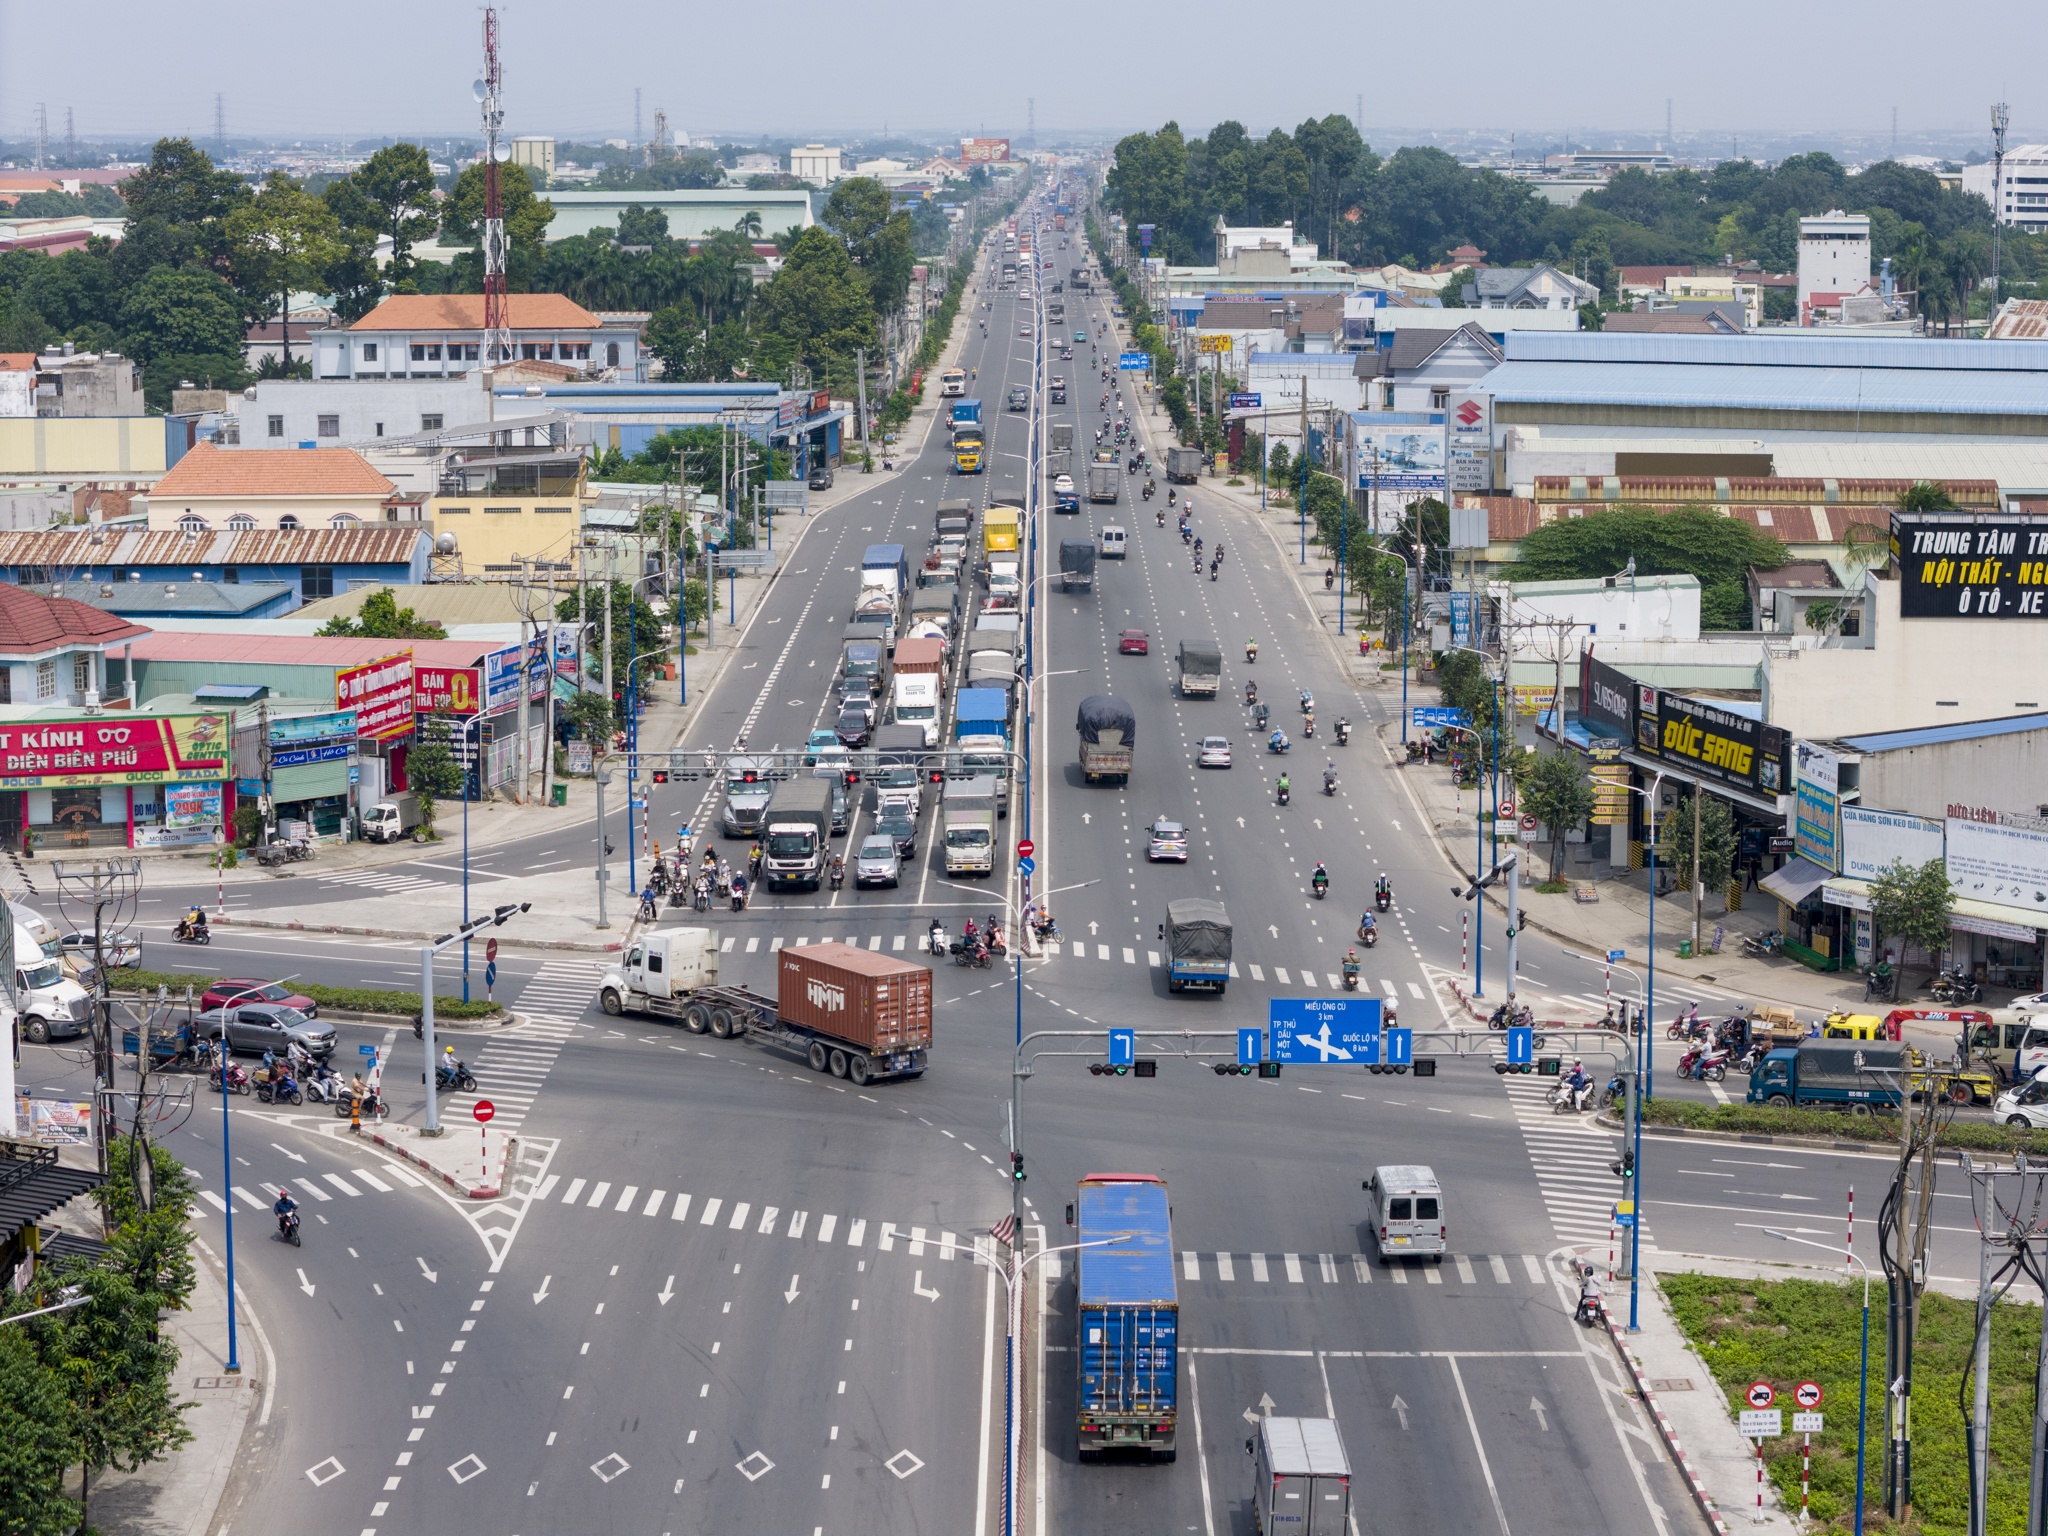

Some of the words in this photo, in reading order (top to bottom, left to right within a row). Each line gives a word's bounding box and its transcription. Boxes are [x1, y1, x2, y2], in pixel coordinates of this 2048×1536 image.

[1912, 531, 1971, 555] TRUNG
[1977, 529, 2016, 554] TÂM
[1921, 557, 1955, 588] NỘI
[1959, 556, 2002, 584] THẤT
[1958, 586, 1971, 613] Ô
[1977, 587, 2001, 613] TÔ
[2018, 591, 2044, 613] XE
[422, 671, 445, 689] BÁN
[416, 689, 433, 707] TRẢ
[1643, 689, 1654, 705] 3M
[21, 728, 84, 748] KÍNH
[1663, 714, 1704, 758] ĐỨC
[1702, 733, 1754, 775] SANG
[192, 741, 223, 751] OPTIC
[54, 750, 95, 768] BIÊN
[102, 745, 138, 766] PHỦ
[186, 750, 228, 760] CENTER
[2, 777, 43, 787] POLICE
[125, 772, 164, 781] GUCCI
[177, 770, 220, 779] PRADA
[169, 791, 190, 800] COMBO
[134, 804, 143, 816] ĐO
[174, 800, 203, 817] 299K
[1947, 802, 1967, 819] ĐỨC
[1971, 806, 1997, 825] LIÊM
[1844, 810, 1857, 821] CỬA
[1858, 811, 1877, 824] HÀNG
[1878, 815, 1892, 826] SƠN
[1893, 818, 1906, 828] KEO
[1961, 823, 1976, 832] CÔNG
[2009, 830, 2020, 838] DỊCH
[1772, 839, 1793, 847] Audio
[1851, 861, 1875, 873] DUNG
[1857, 920, 1870, 933] PHA
[1857, 936, 1870, 949] SƠN
[807, 982, 845, 1012] HMM
[1305, 1001, 1320, 1011] MIẾU
[1322, 1001, 1336, 1011] ÔNG
[1283, 1018, 1296, 1029] THỦ
[1318, 1013, 1323, 1021] 3
[1324, 1013, 1334, 1021] km
[1277, 1040, 1290, 1049] MỘT
[1343, 1032, 1360, 1042] QUỐC
[1361, 1034, 1370, 1043] LỘ
[1371, 1034, 1379, 1042] 1K
[1353, 1044, 1357, 1052] 8
[1358, 1044, 1368, 1052] km
